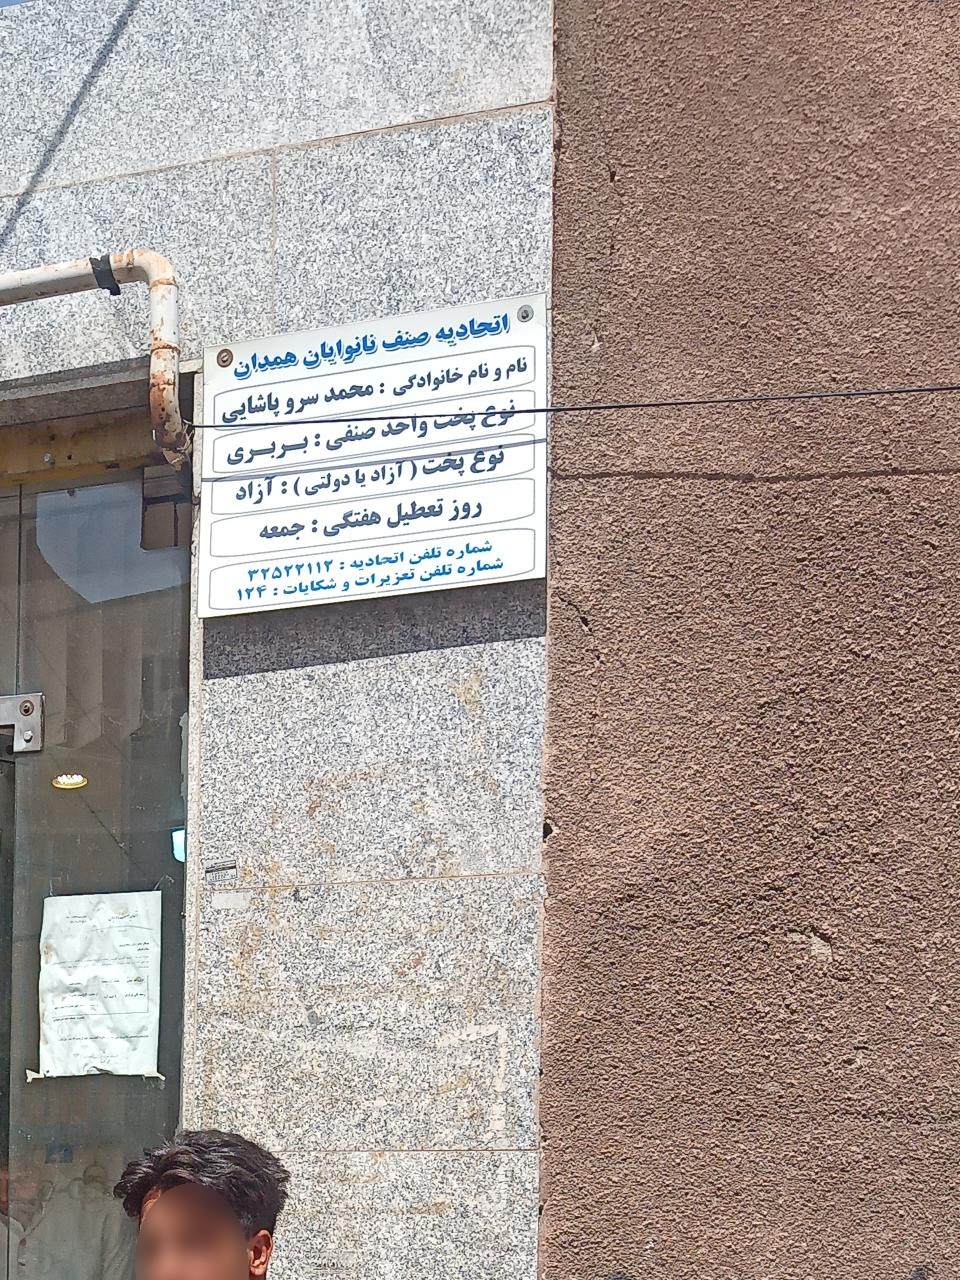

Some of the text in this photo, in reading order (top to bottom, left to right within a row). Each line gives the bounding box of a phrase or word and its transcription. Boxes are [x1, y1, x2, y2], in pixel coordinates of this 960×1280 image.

[233, 313, 510, 379] اتحادیه صنف نانوایان همدان
[468, 363, 489, 385] نام
[493, 367, 502, 381] و
[506, 357, 527, 378] نام
[393, 367, 463, 396] خانوادگی
[324, 383, 374, 402] محمد
[222, 392, 279, 423] پاشایی
[481, 399, 516, 428] نوع
[381, 414, 428, 438] واحد
[433, 407, 476, 431] پخت
[326, 424, 376, 451] صنفی
[422, 452, 464, 476] پخت
[470, 445, 504, 473] نوع
[355, 469, 366, 487] یا
[235, 476, 276, 505] آزاد
[387, 498, 443, 528] تعطیل
[448, 500, 482, 521] روز
[259, 522, 305, 540] جمعه
[324, 508, 381, 537] هفتگی
[409, 546, 442, 565] تلفن
[446, 540, 493, 559] شماره
[350, 551, 404, 571] اتحادیه
[457, 557, 504, 576] شماره
[355, 568, 415, 588] تعزیرات
[419, 564, 452, 582] تلفن
[237, 585, 267, 601] ۱۲۴
[283, 578, 337, 595] شکایات
[341, 580, 350, 591] و
